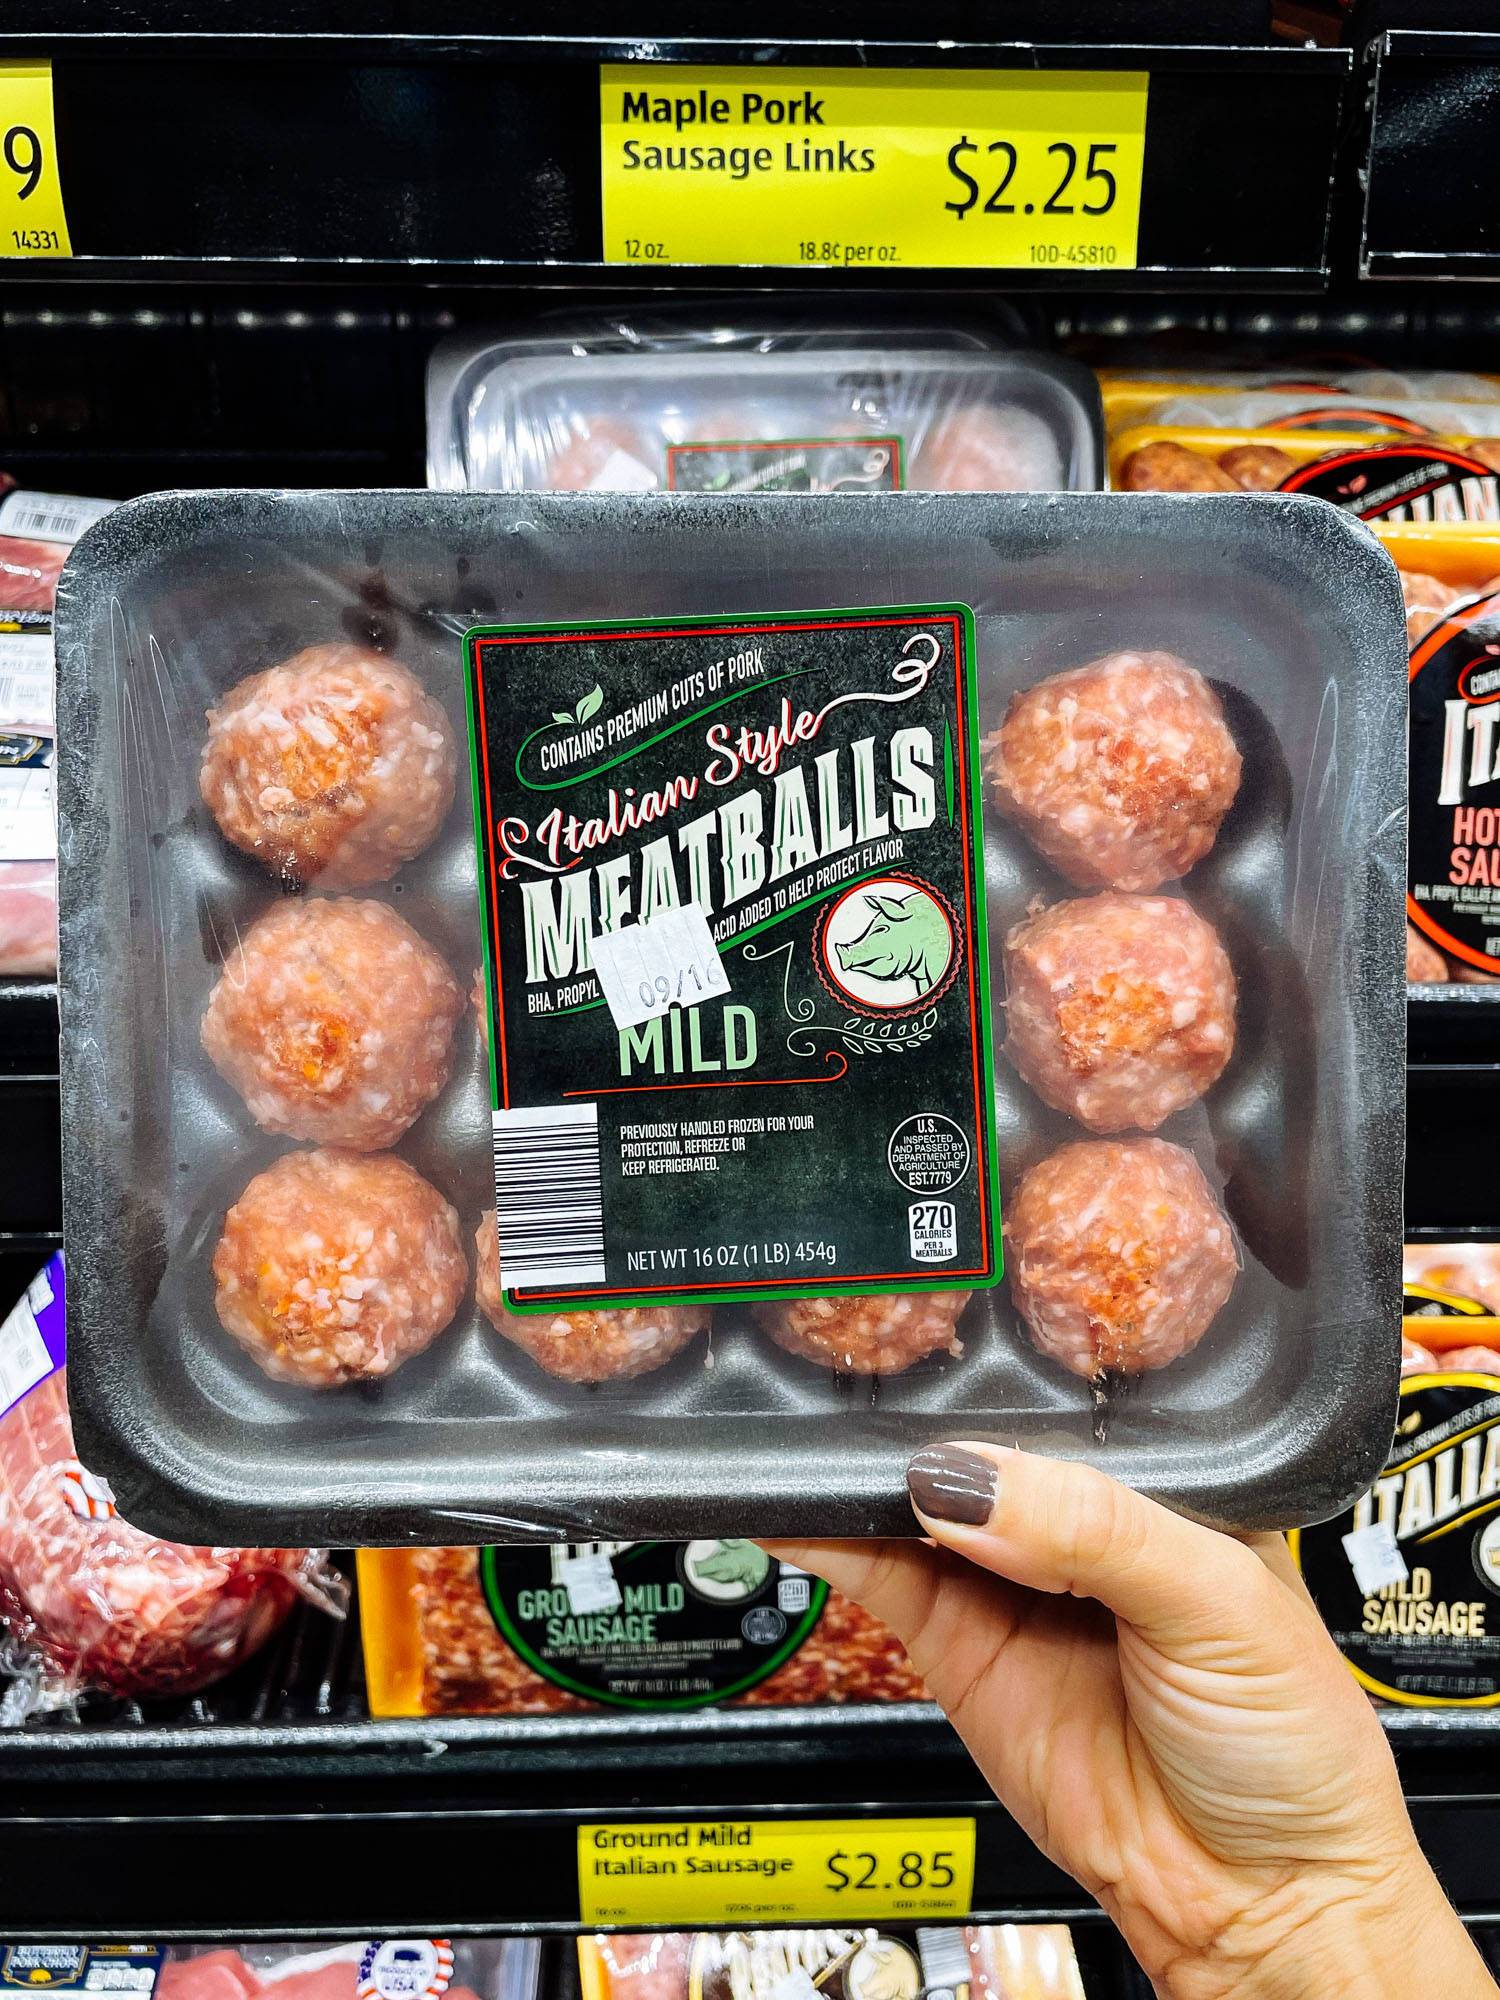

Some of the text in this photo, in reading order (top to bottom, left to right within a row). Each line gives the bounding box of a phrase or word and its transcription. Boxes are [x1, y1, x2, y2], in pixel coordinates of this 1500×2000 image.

[622, 89, 825, 132] Maple Pork
[3, 126, 43, 201] 9
[622, 138, 876, 181] Sausage Links
[944, 134, 1118, 221] $2.25
[12, 229, 60, 250] 14331
[624, 239, 670, 259] 12 oz.
[844, 245, 875, 267] per
[878, 245, 902, 262] oz.
[1030, 245, 1117, 264] 10D-45810
[540, 647, 765, 772] CONTAINS PREMIUM CUTS OF PORK
[1437, 699, 1500, 805] IT
[499, 697, 826, 880] Italian Style
[519, 726, 936, 984] MEATBALLS
[713, 839, 905, 943] ACID ADDED TO HELP PROTECT FLAVOR
[638, 958, 725, 1008] 09/16
[527, 979, 600, 1014] BHA, PROPYL
[618, 1004, 758, 1077] MILD
[620, 1115, 815, 1140] PREVIOUSLY HANDLED FROZEN FOR YOUR
[903, 1134, 954, 1145] INSPECTED
[917, 1119, 938, 1134] U.S.
[621, 1137, 746, 1158] PROTECTION, REFREEZE OR
[892, 1151, 966, 1163] DEPARTMENT OF
[894, 1142, 964, 1154] AND PASSED BY
[622, 1157, 720, 1176] KEEP REFRIGERATED.
[898, 1160, 961, 1171] AGRICULTURE
[908, 1171, 952, 1186] EST.7779
[912, 1205, 952, 1230] 270
[914, 1229, 952, 1240] CALORIES
[924, 1241, 943, 1249] PER 3
[627, 1240, 837, 1271] NET WT 16 OZ (1 LB) 454g
[915, 1248, 953, 1258] MEATBALLS
[1364, 1567, 1432, 1601] ILD
[623, 1582, 685, 1613] MILD
[547, 1614, 657, 1646] SAUSAGE
[1362, 1600, 1486, 1638] SAUSAGE
[593, 1824, 752, 1850] Ground Mild
[594, 1854, 794, 1877] Italian Sausage
[824, 1849, 956, 1893] $2.85
